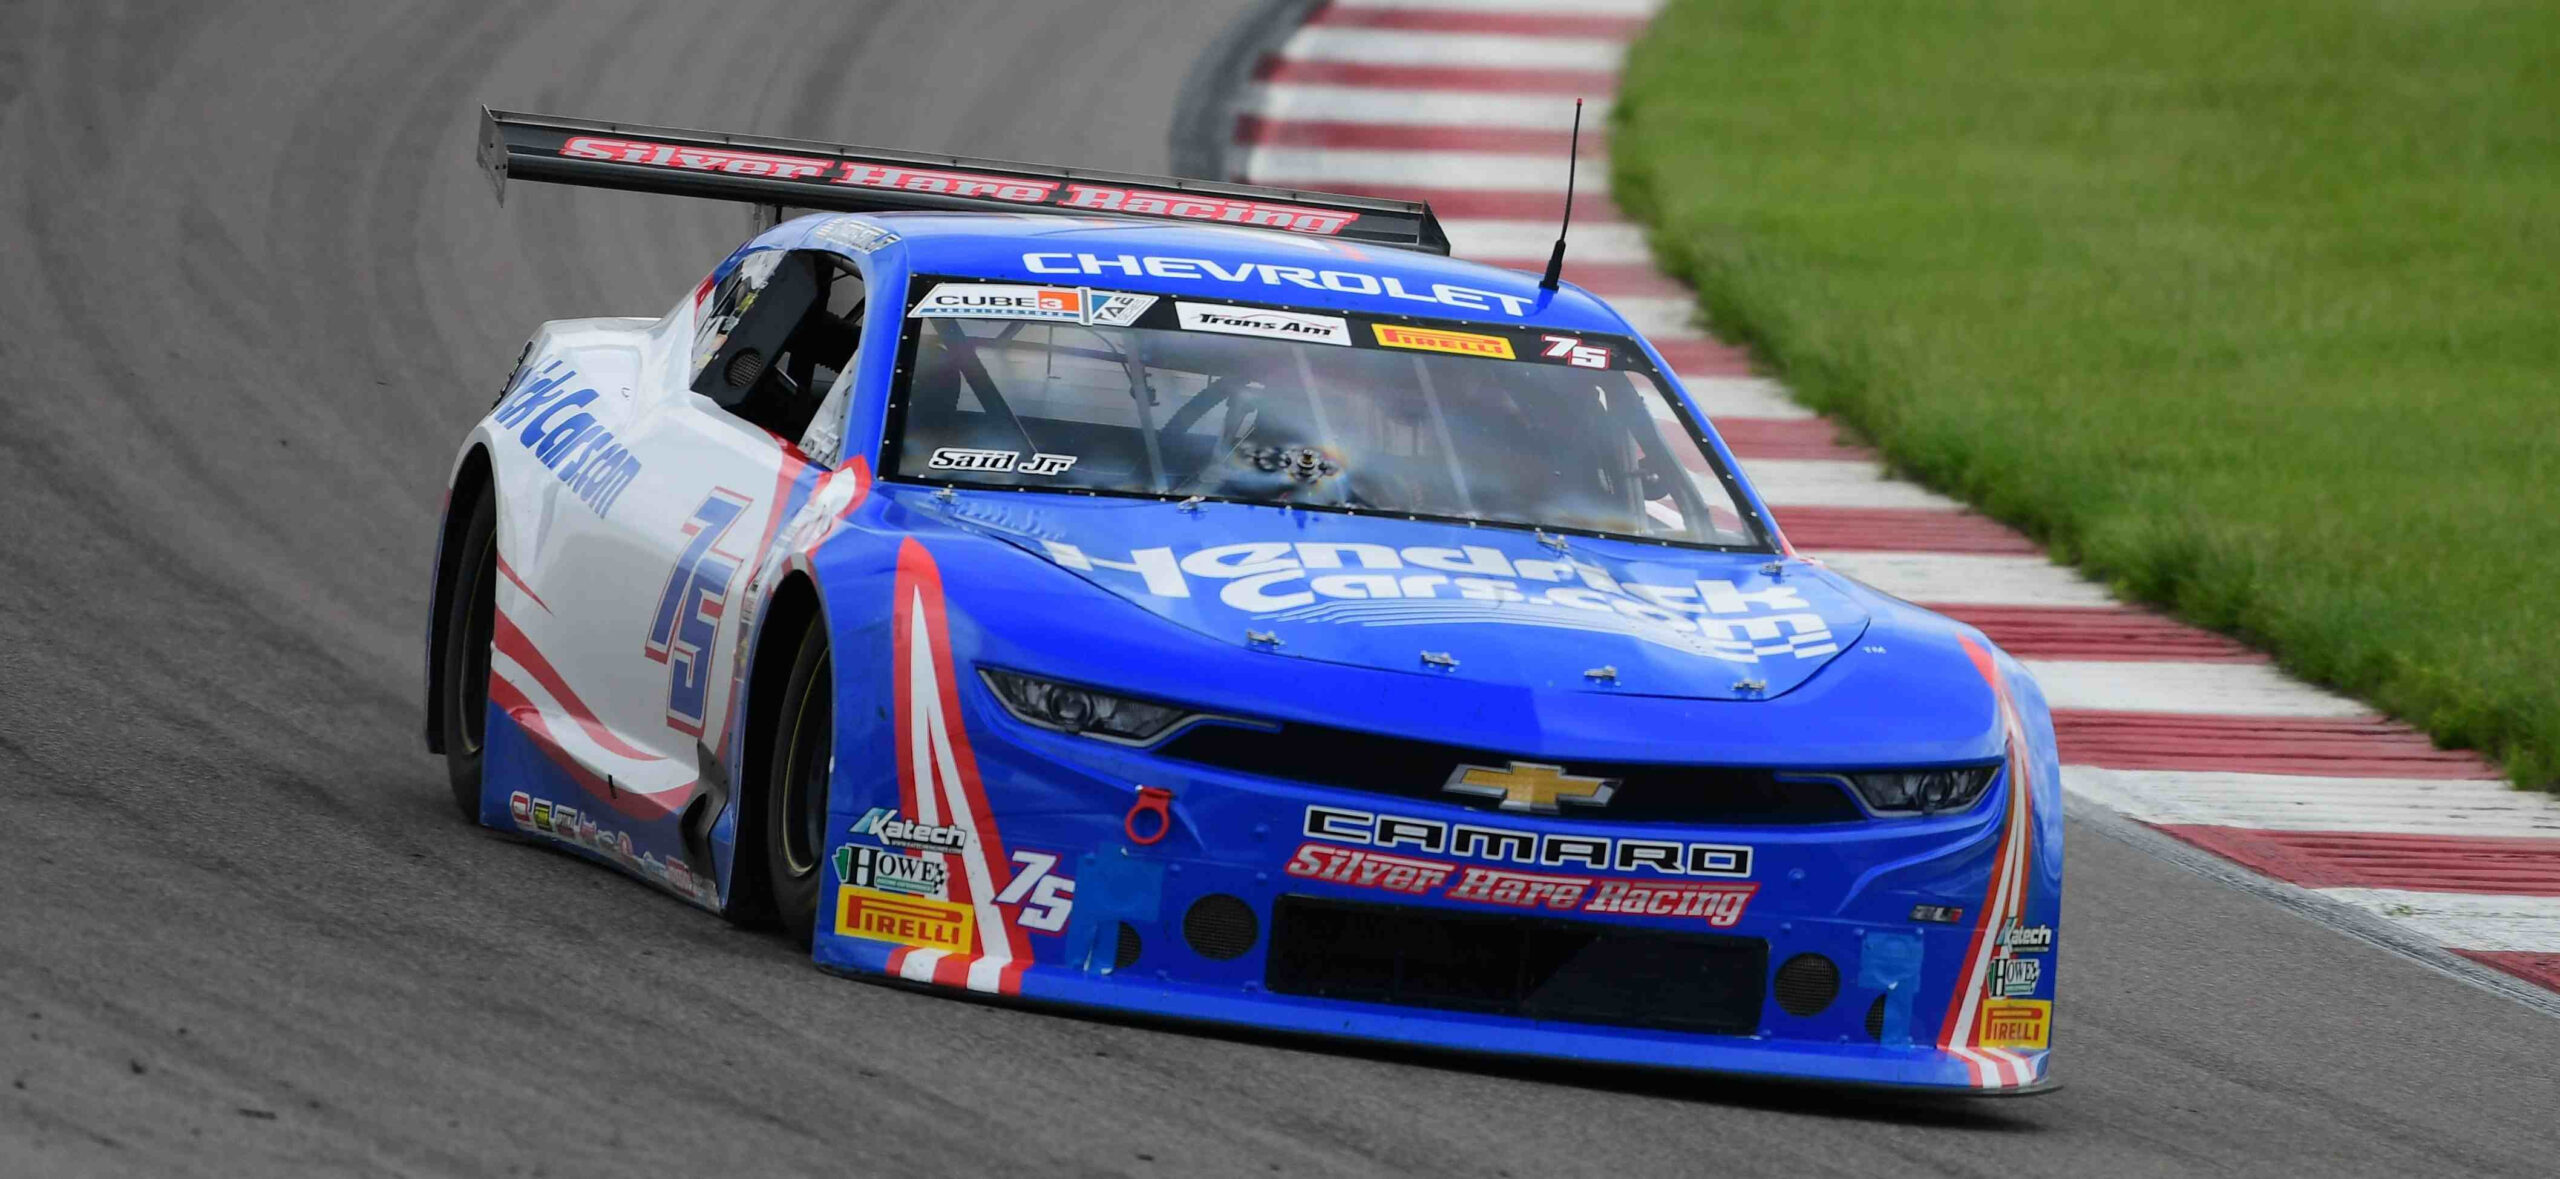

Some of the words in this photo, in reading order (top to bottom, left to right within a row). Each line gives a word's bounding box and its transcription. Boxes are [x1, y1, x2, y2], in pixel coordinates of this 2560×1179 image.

[561, 136, 833, 179] Silver
[832, 161, 1060, 204] Hare
[1057, 182, 1360, 236] Racing
[935, 294, 1036, 309] CUBE
[1022, 252, 1533, 317] CHEVROLET
[1199, 313, 1273, 332] Trans
[1279, 318, 1333, 336] Am
[1383, 328, 1506, 356] PIRELLI
[1540, 334, 1610, 369] 75
[929, 448, 1019, 473] Said
[1018, 452, 1077, 475] Jr
[1041, 539, 1810, 613] Hendrick
[644, 486, 754, 737] 75
[1220, 568, 1839, 663] Cars.com
[851, 807, 967, 849] Katech
[1303, 805, 1753, 877] CAMARO
[849, 846, 938, 888] HOWE
[1285, 843, 1455, 893] Silver
[1445, 867, 1595, 909] Hare
[1584, 880, 1760, 927] Racing
[992, 850, 1076, 934] 75
[847, 894, 963, 945] PIRELLI
[1996, 917, 2052, 952] Katech
[1992, 958, 2036, 997] HOWE
[1985, 1007, 2043, 1041] PIRELLI
